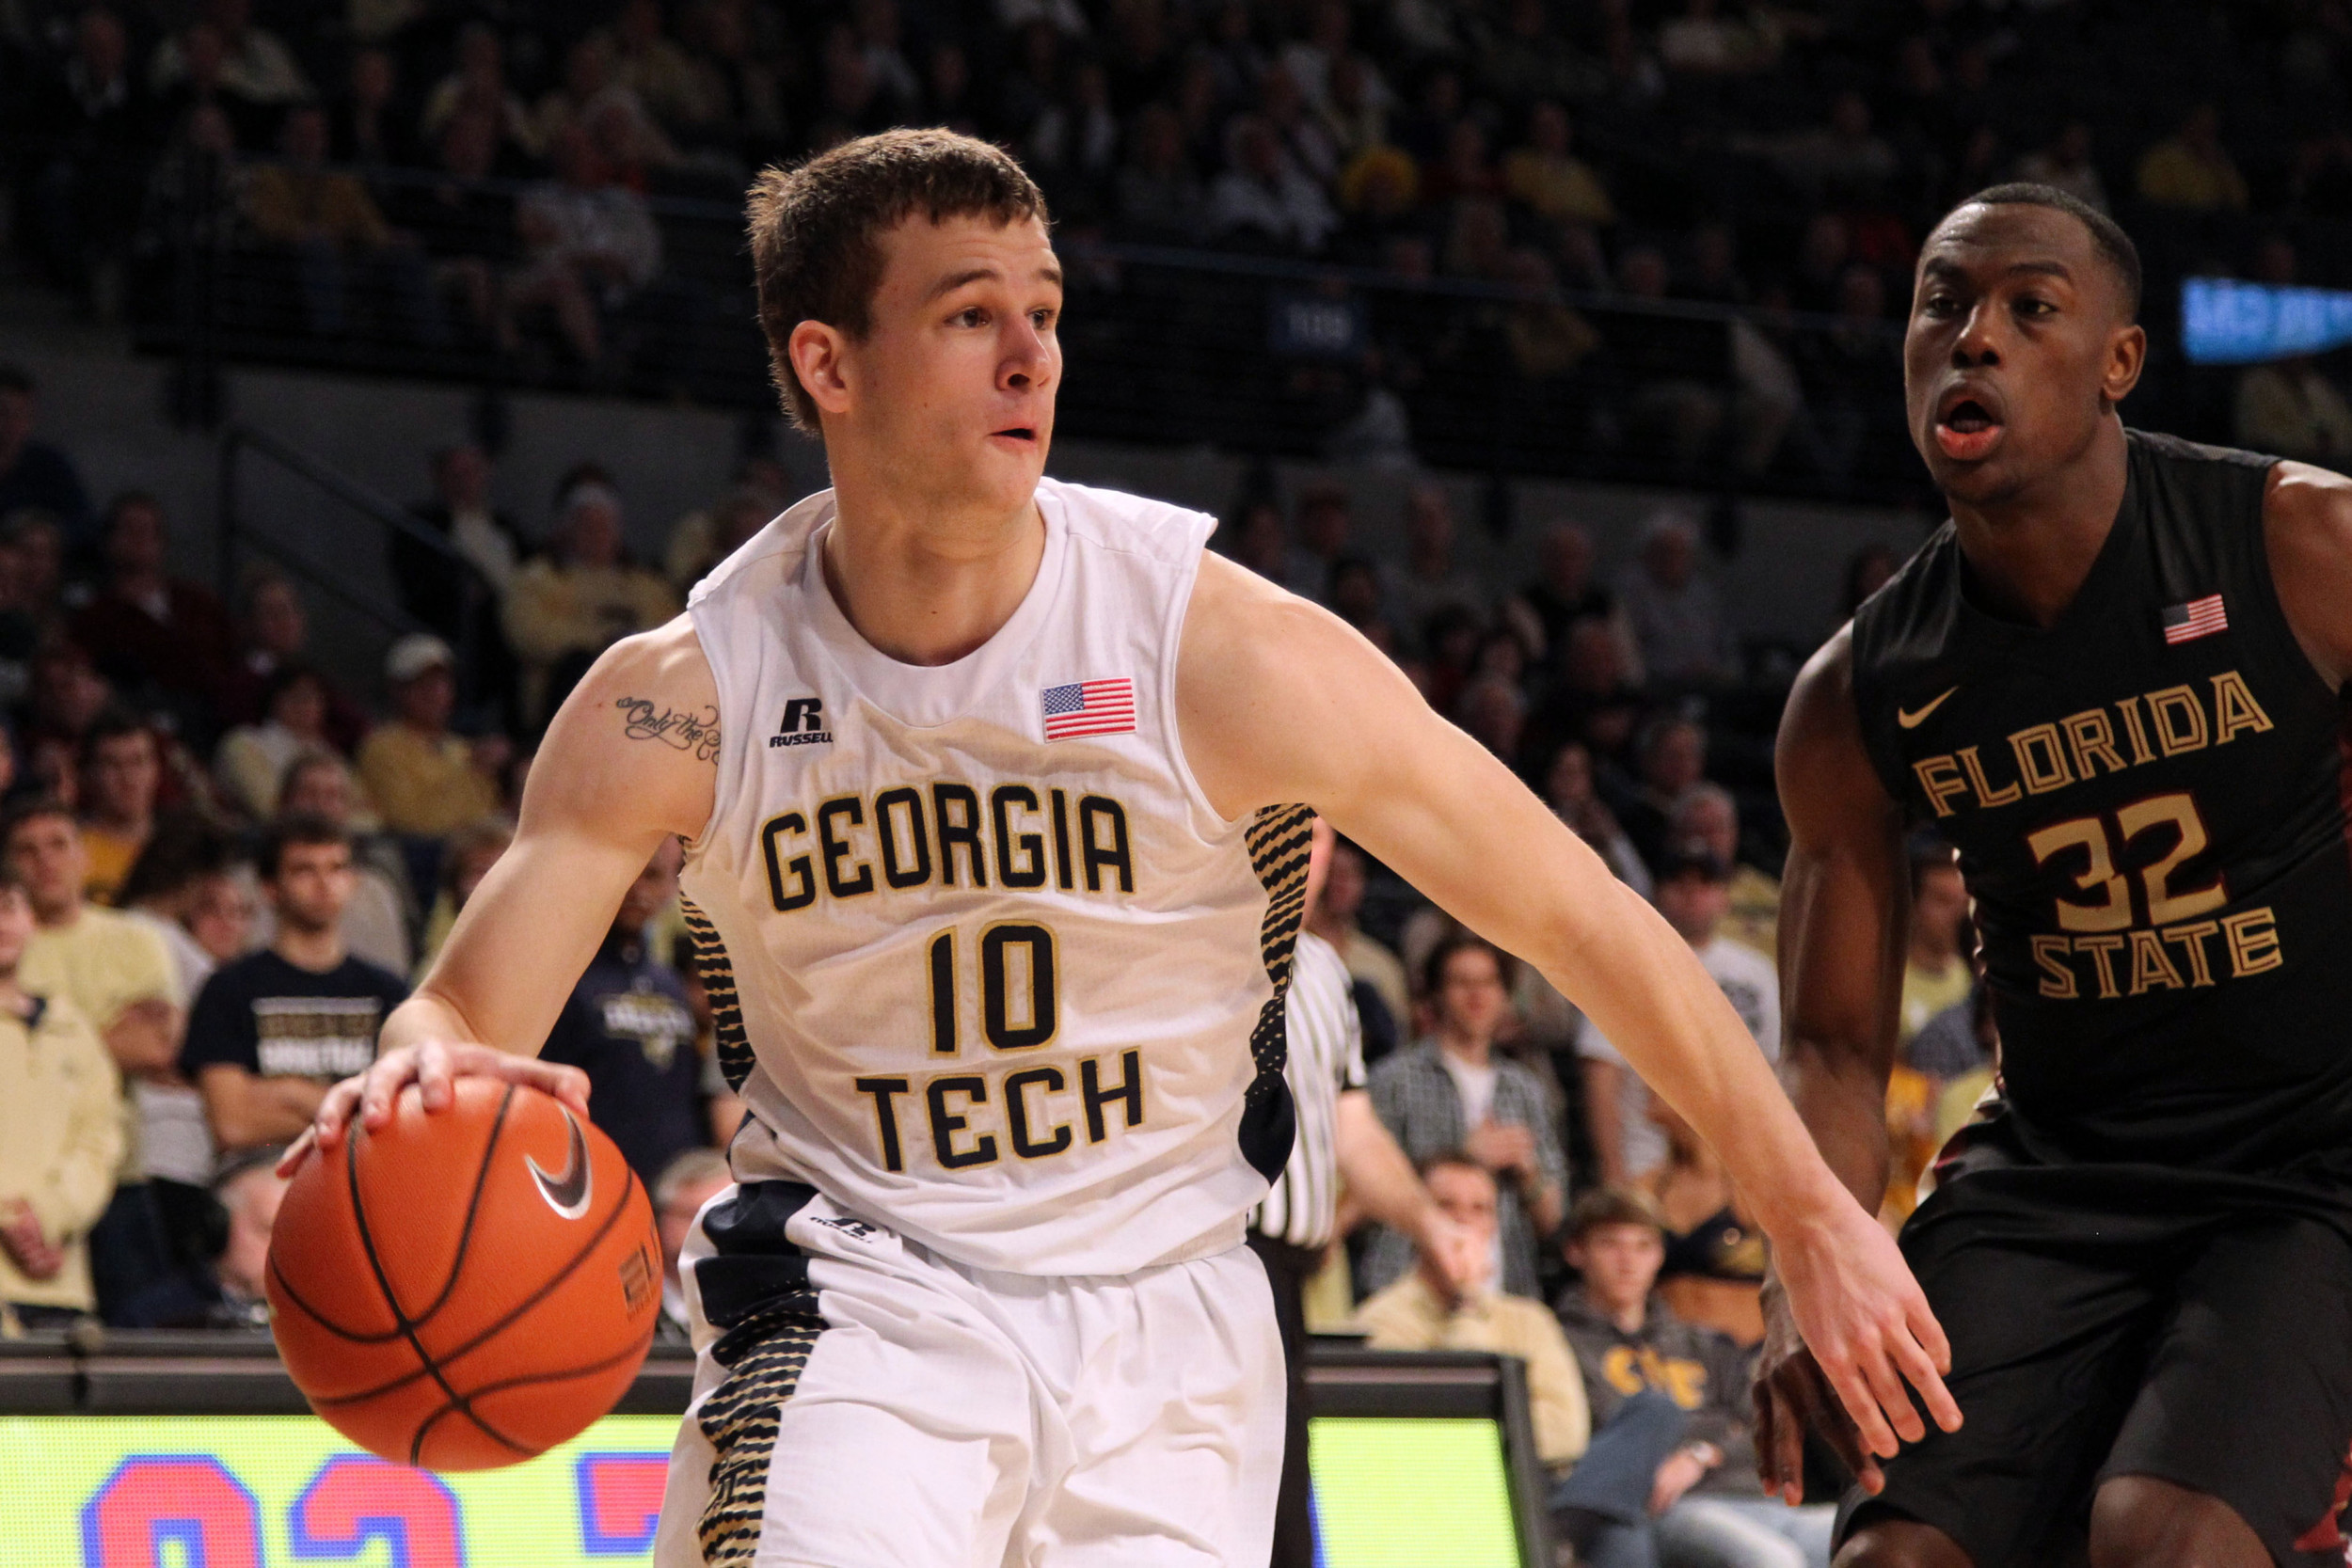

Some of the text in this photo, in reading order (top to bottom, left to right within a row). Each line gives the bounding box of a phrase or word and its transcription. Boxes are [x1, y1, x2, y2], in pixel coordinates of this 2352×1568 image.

[770, 732, 834, 748] RUSSELL
[1912, 670, 2275, 817] FLORIDA
[758, 781, 1136, 912] GEORGIA
[2026, 792, 2230, 933] 32
[926, 919, 1059, 1058] 10
[2029, 906, 2284, 999] STATE
[852, 1046, 1146, 1173] TECH
